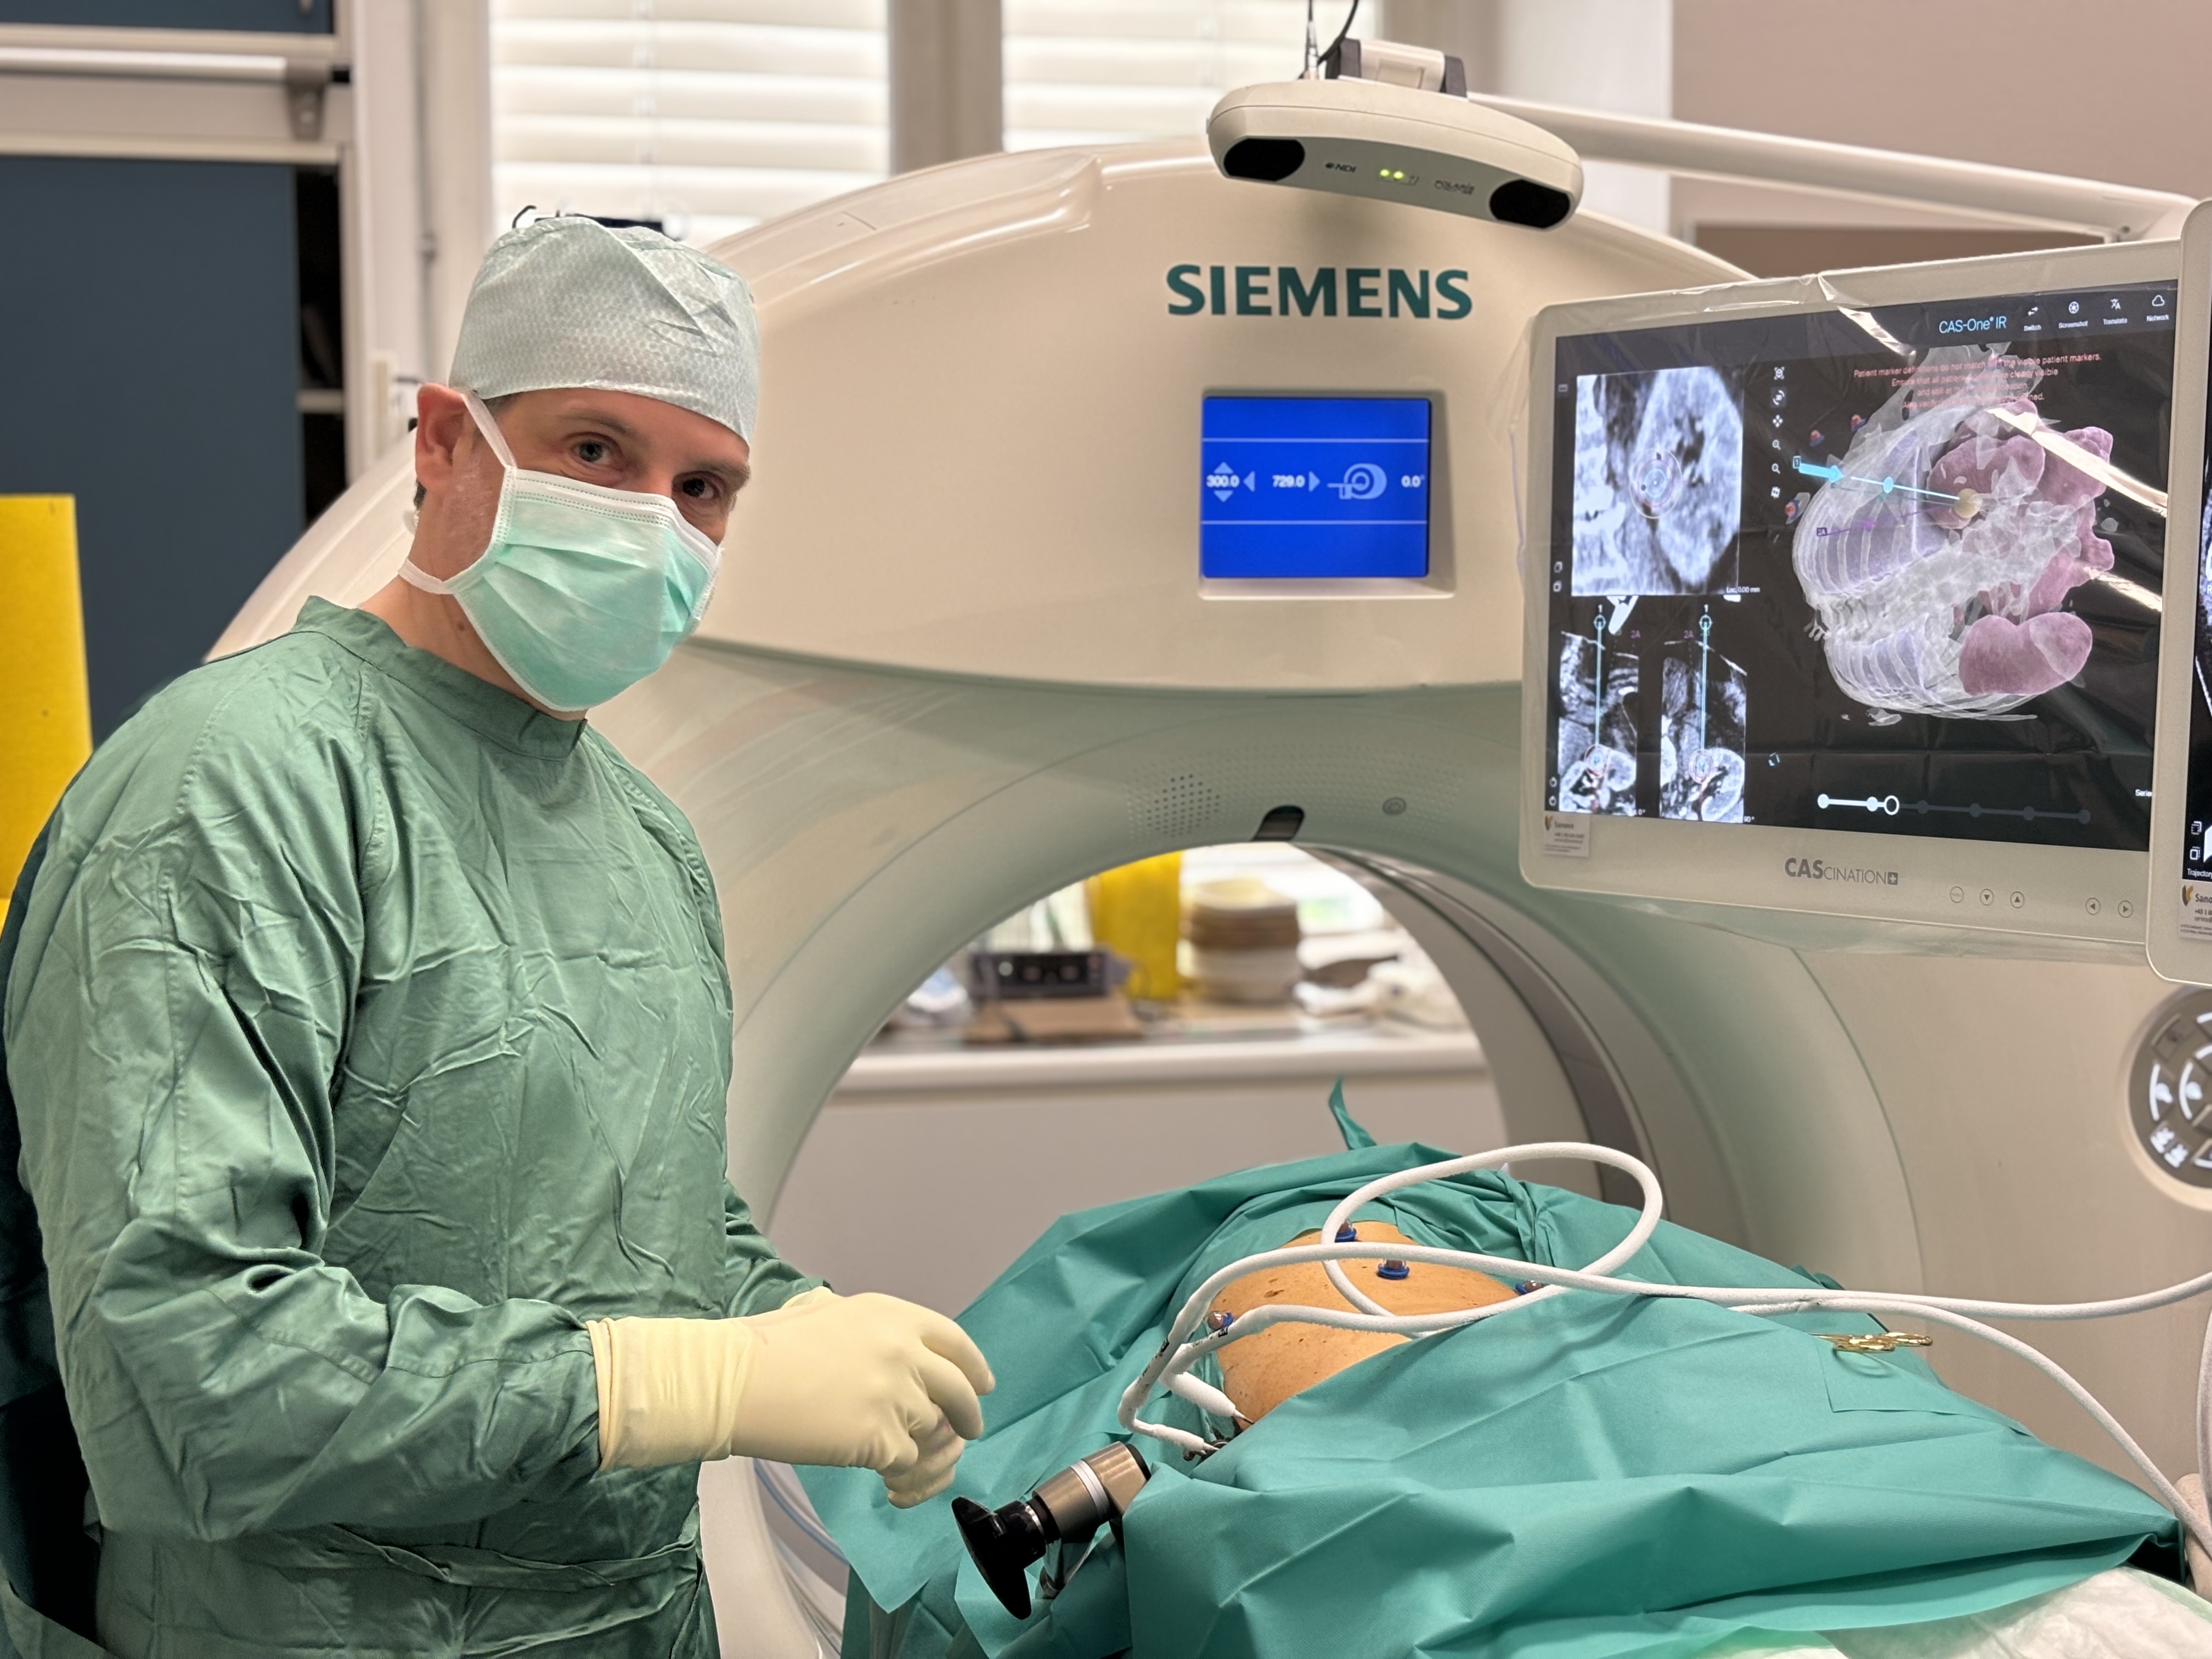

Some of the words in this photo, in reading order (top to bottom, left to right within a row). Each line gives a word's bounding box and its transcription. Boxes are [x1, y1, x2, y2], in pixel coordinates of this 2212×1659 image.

[1166, 264, 1472, 320] SIEMENS
[1995, 315, 2007, 329] IR
[2058, 320, 2088, 329] Screenshot
[1854, 369, 1877, 377] Patient
[1878, 368, 1902, 376] marker
[2042, 356, 2068, 365] patient
[2069, 353, 2102, 362] markers.
[1206, 475, 1239, 487] 300.0
[1272, 475, 1305, 487] 729.0
[1630, 630, 1641, 639] 2A
[1683, 630, 1694, 639] 2A
